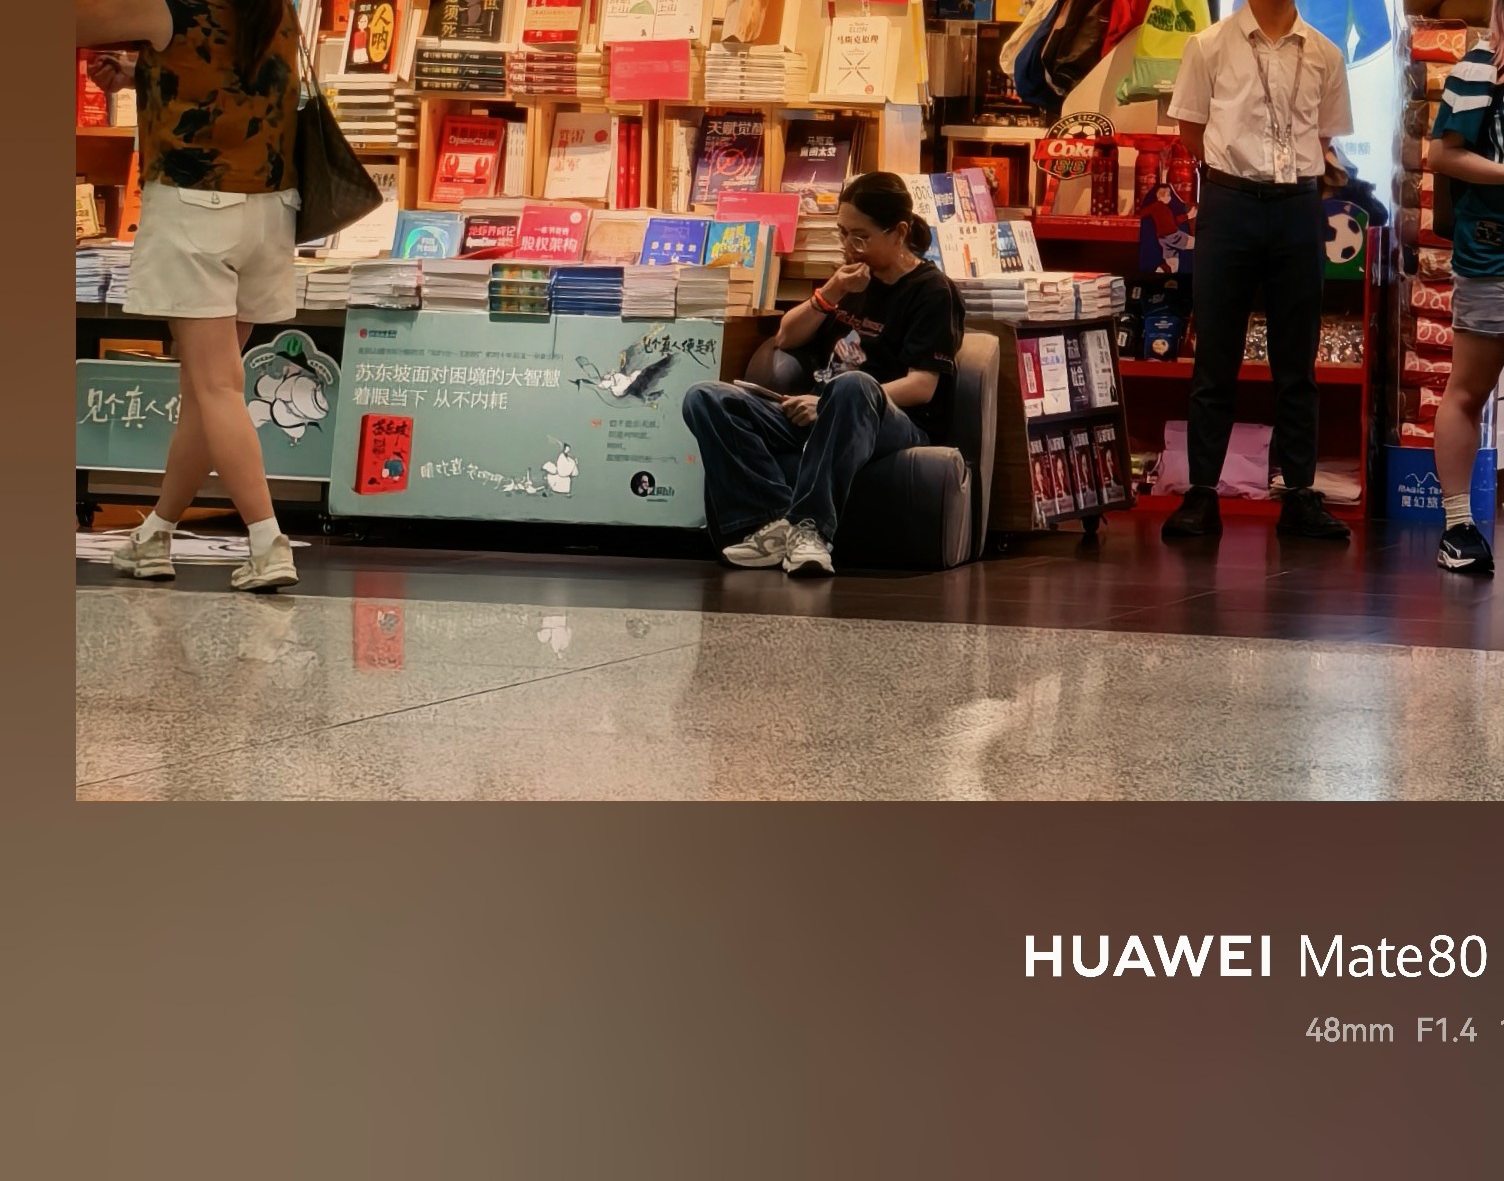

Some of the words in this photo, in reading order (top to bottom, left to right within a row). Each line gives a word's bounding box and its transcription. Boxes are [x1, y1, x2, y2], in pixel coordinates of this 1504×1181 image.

[355, 363, 562, 388] 苏东坡面对困境的大智慧
[352, 387, 429, 408] 着眼当下
[432, 388, 509, 410] 从不内耗
[1401, 495, 1446, 509] 魔幻旅
